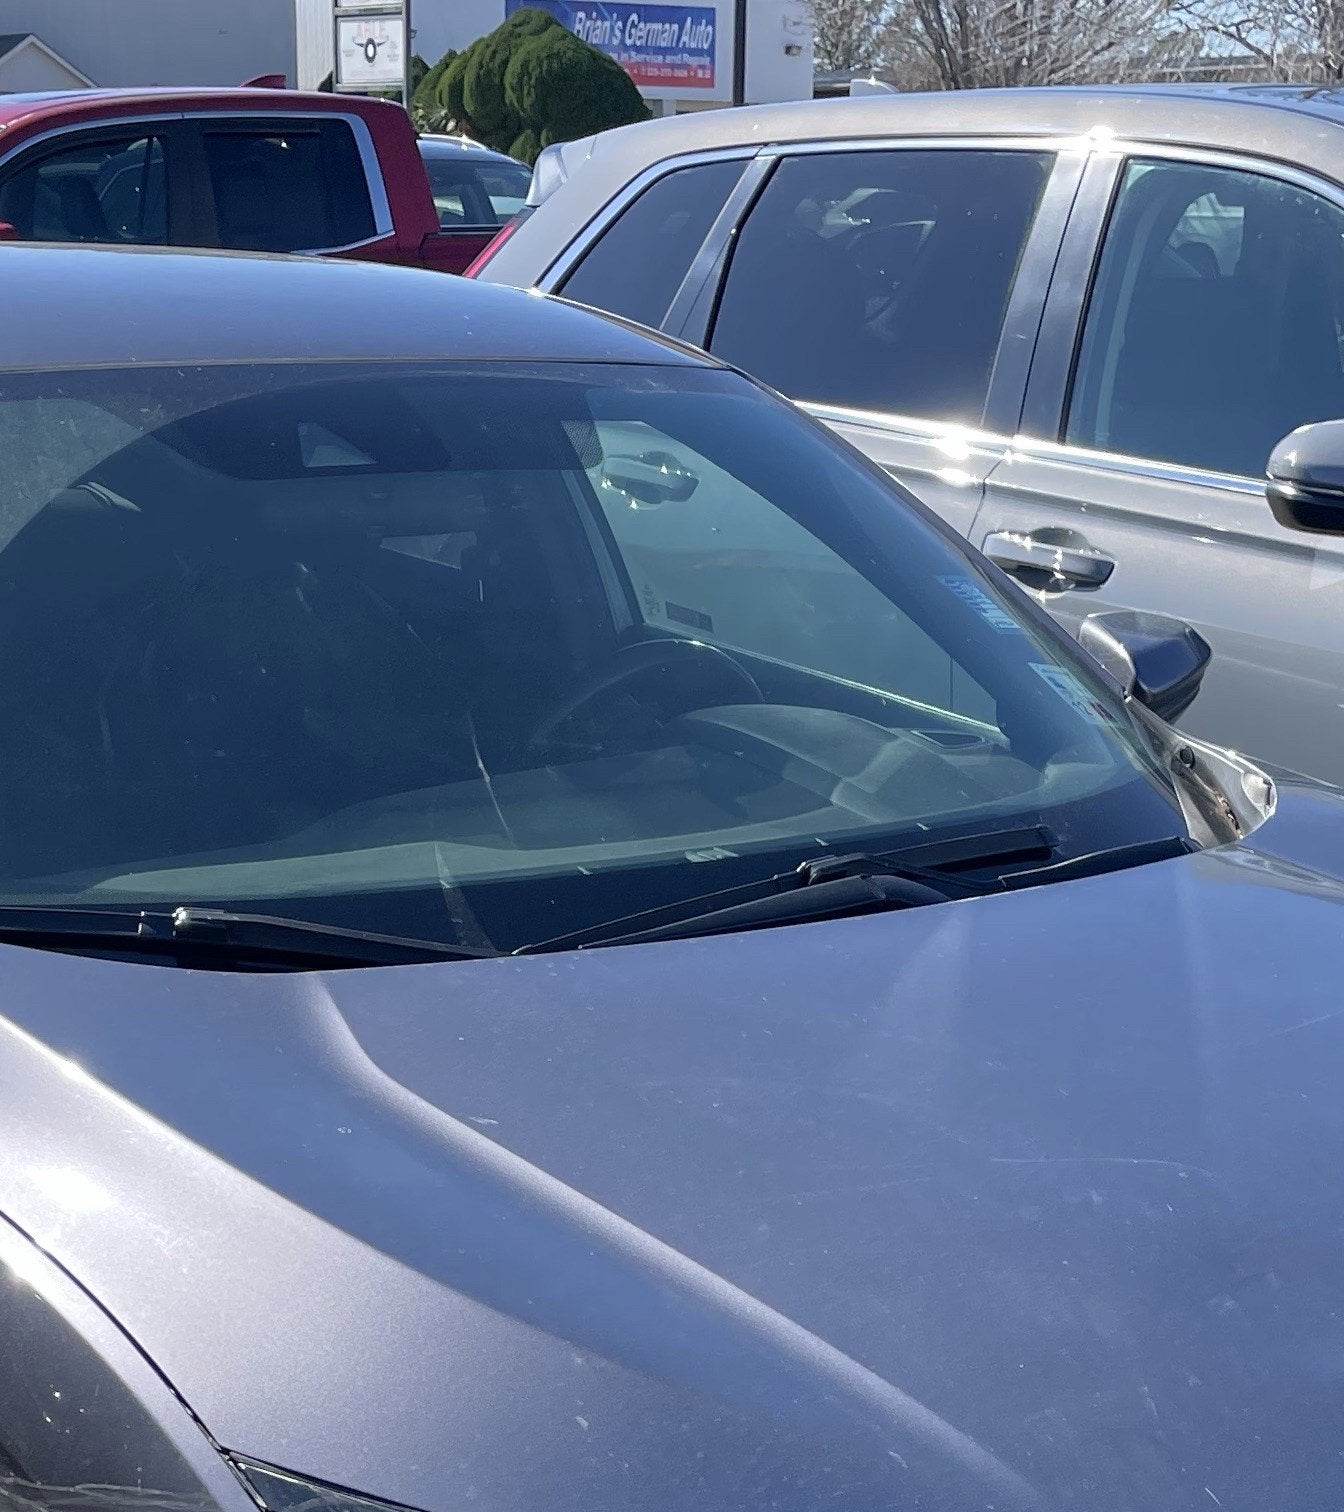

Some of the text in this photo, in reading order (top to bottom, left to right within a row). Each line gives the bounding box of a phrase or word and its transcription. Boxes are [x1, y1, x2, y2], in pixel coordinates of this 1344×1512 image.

[574, 11, 714, 50] Brian's German Auto
